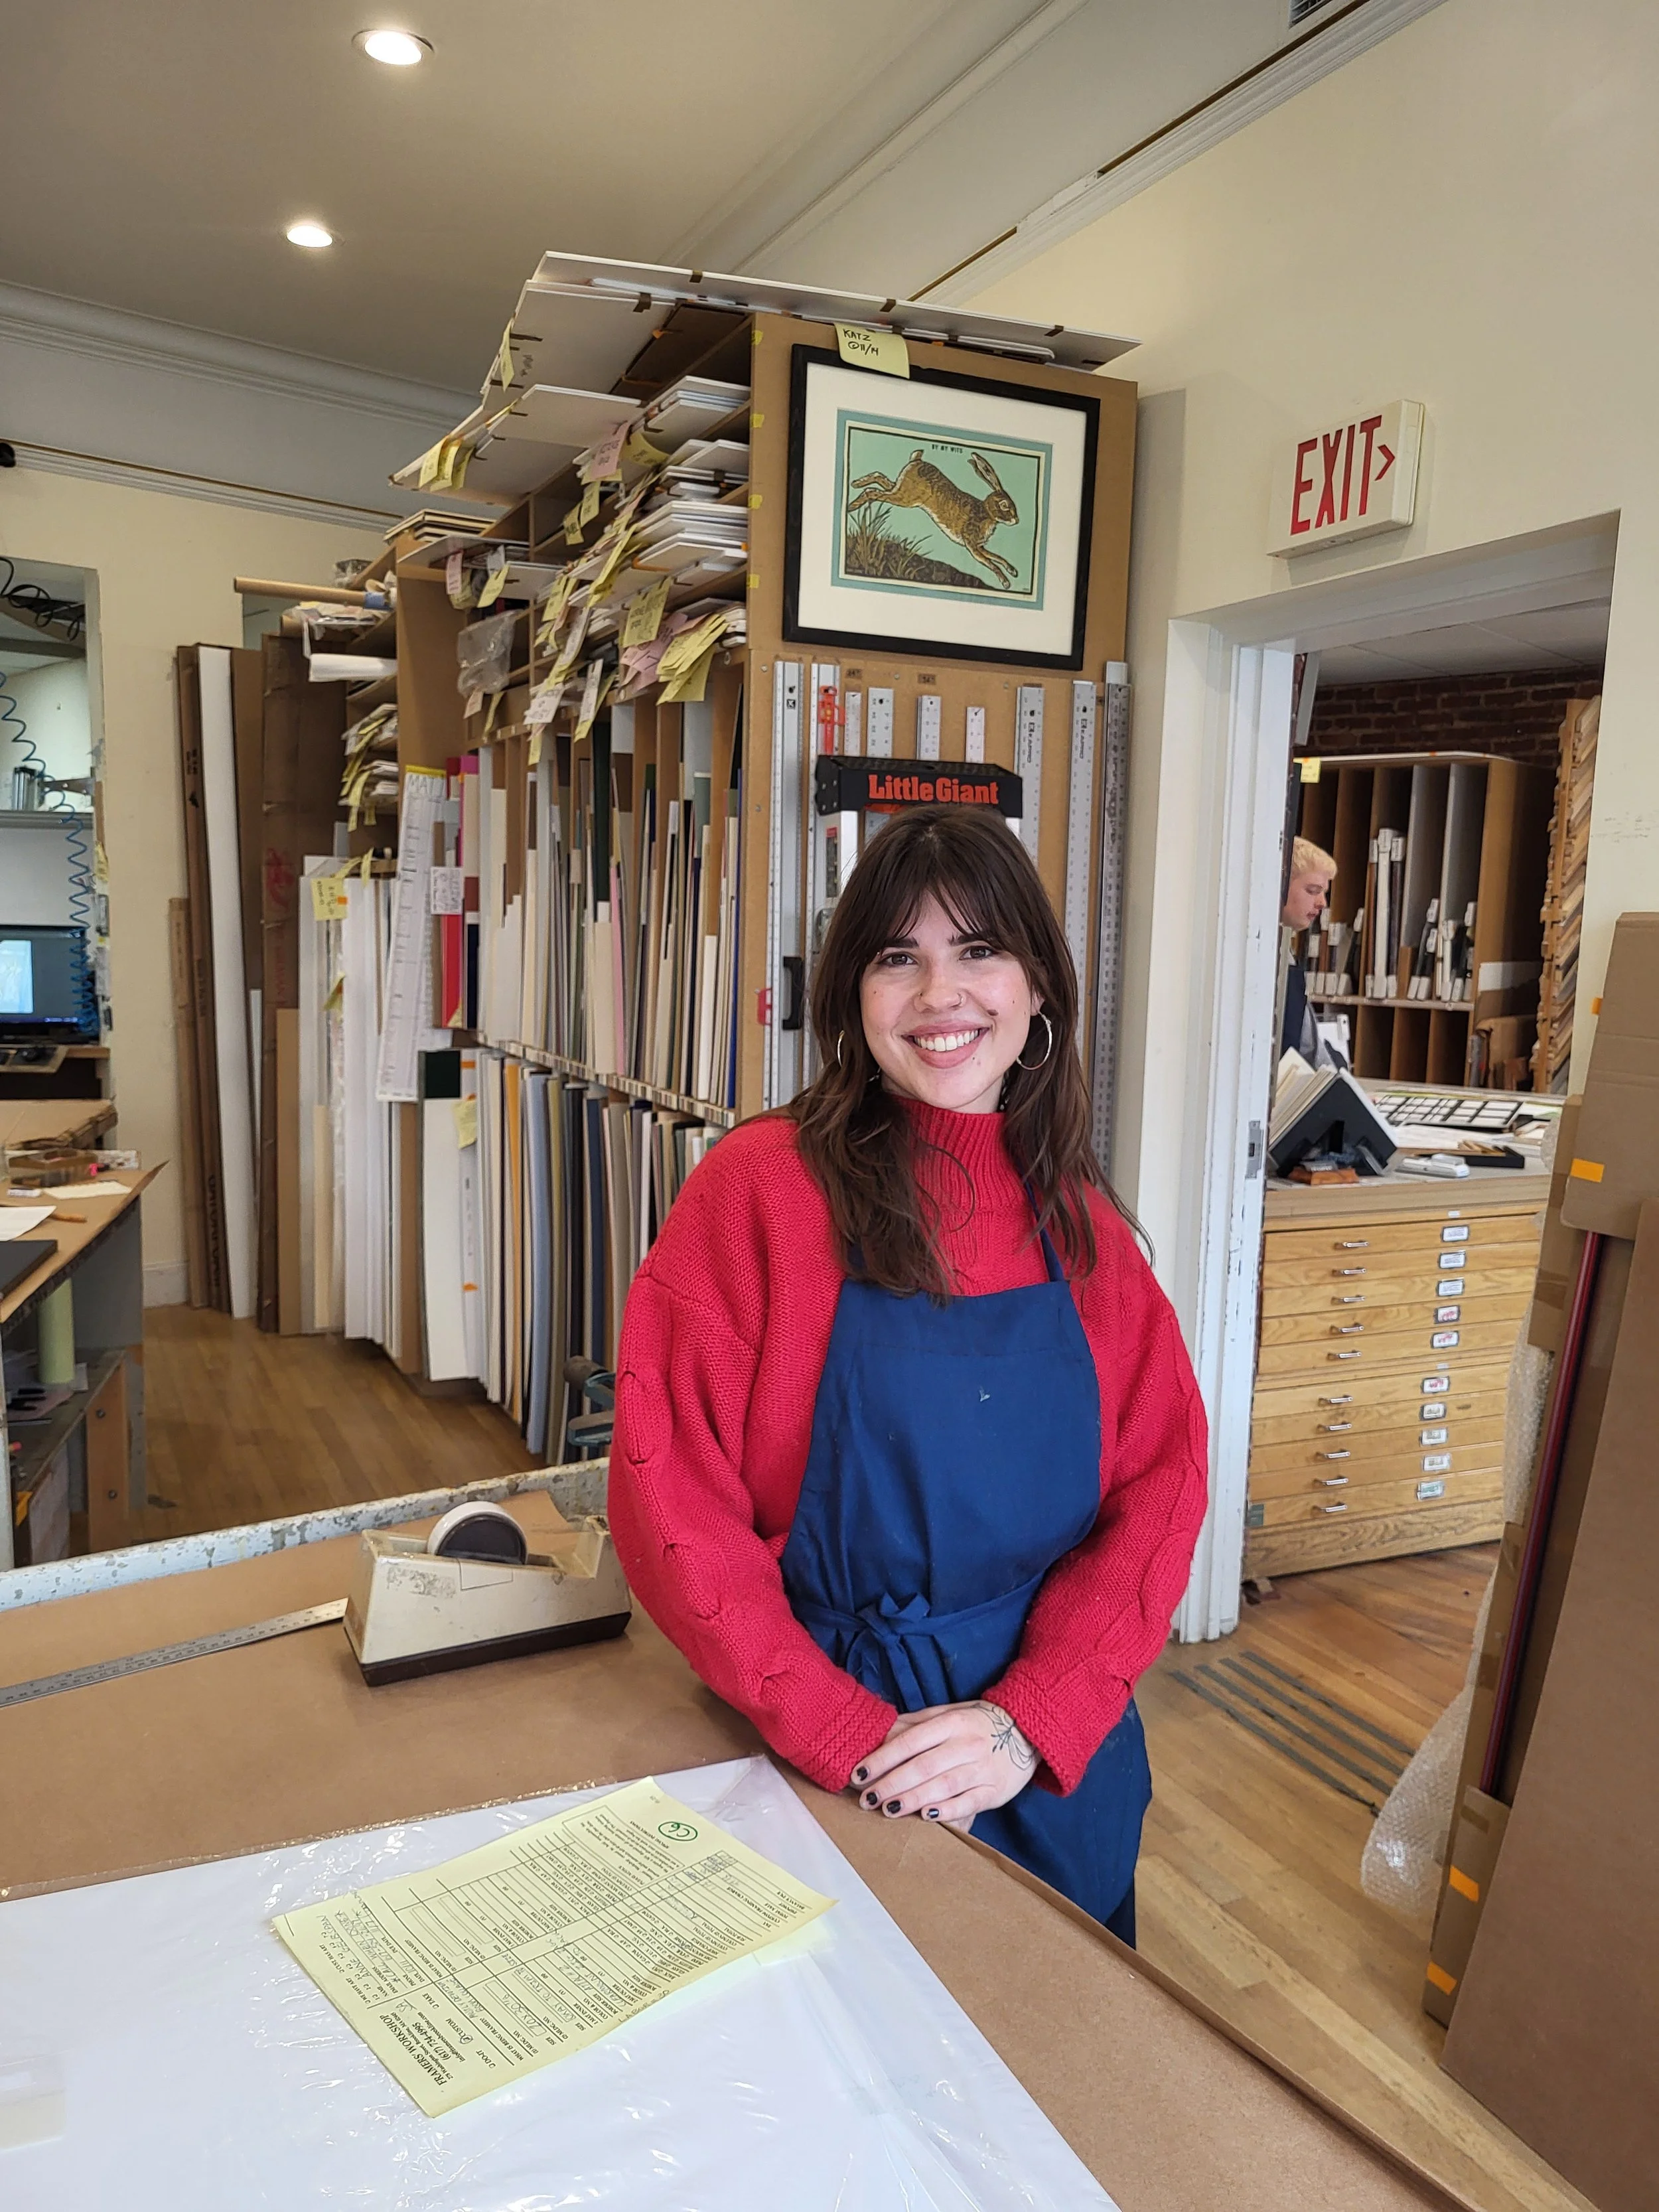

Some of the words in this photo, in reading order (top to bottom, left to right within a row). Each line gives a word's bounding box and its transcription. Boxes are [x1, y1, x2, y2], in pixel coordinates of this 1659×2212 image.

[843, 329, 871, 342] KATZ
[1289, 414, 1382, 536] EXIT
[869, 774, 934, 802] Little
[935, 777, 999, 804] Giant
[422, 1992, 435, 2005] TAKE
[380, 2015, 416, 2053] WORKSHOP
[405, 2026, 421, 2045] Brookline,
[411, 2022, 437, 2047] 734-4995
[445, 2018, 466, 2037] CUSTOM
[433, 2046, 451, 2060] (617)
[411, 2053, 447, 2085] FRAMERS'
[429, 2054, 447, 2073] Washington
